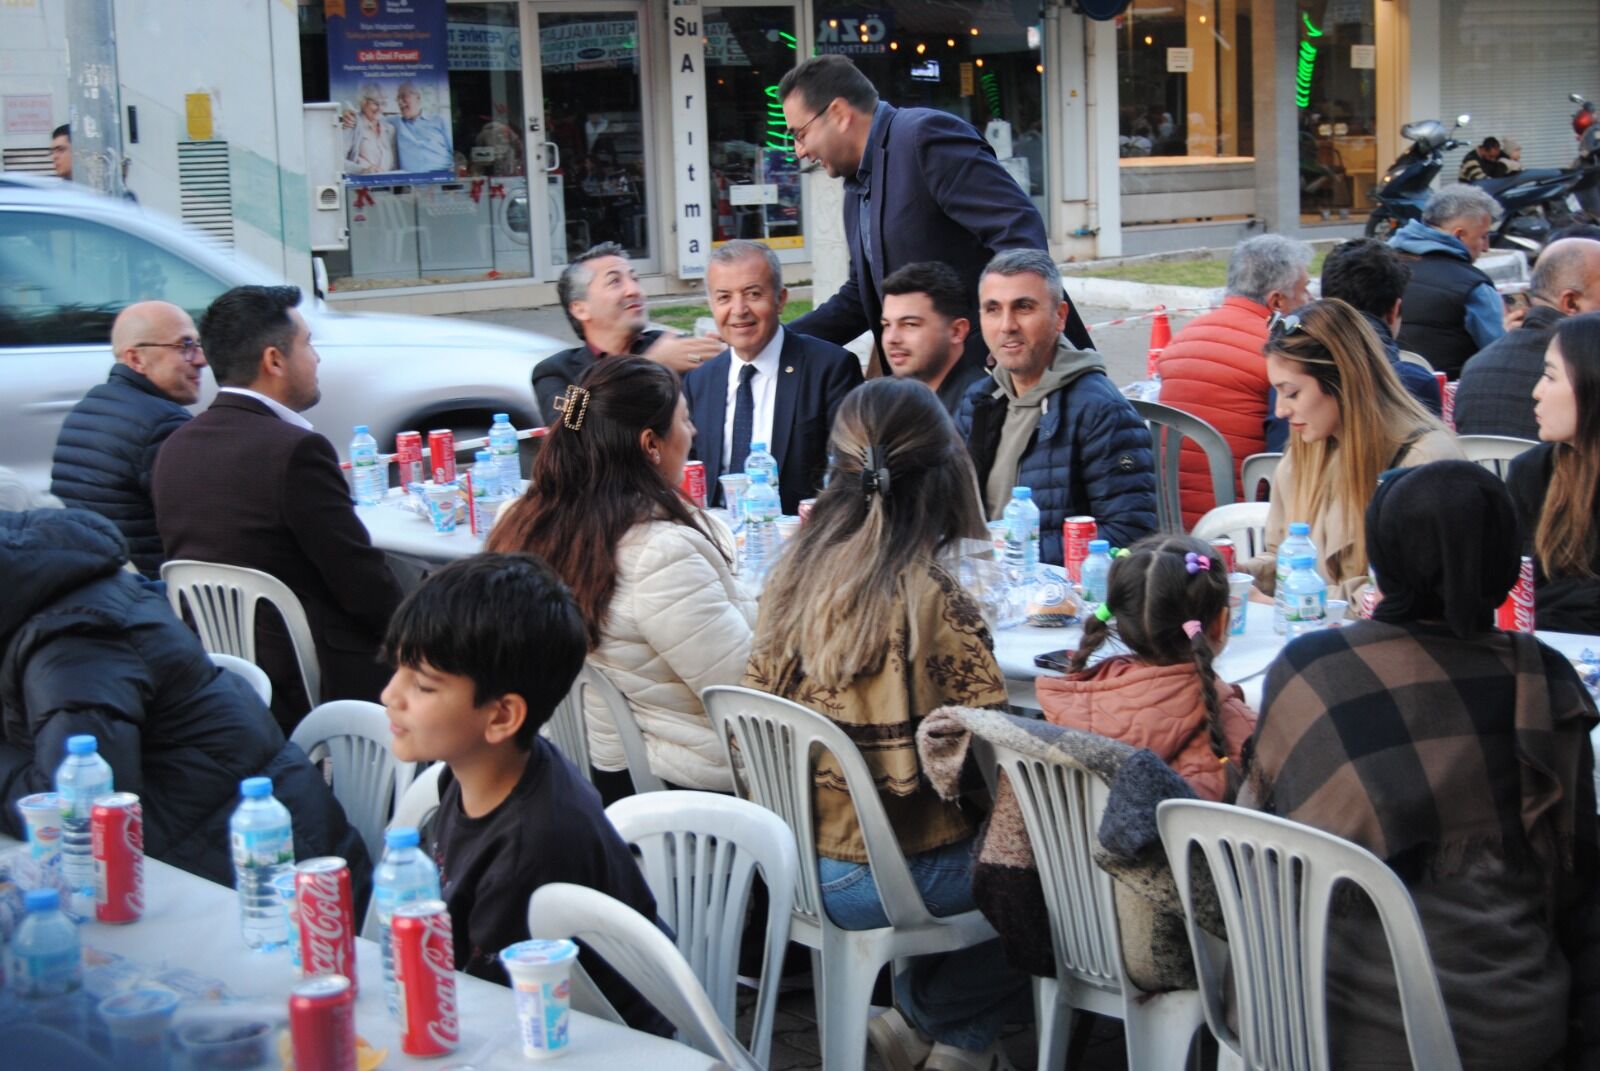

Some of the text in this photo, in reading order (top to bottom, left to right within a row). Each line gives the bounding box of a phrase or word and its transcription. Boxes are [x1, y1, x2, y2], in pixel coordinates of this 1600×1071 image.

[674, 17, 698, 37] Su
[1508, 562, 1535, 633] ca-Cola
[300, 871, 343, 979] ca-Cola
